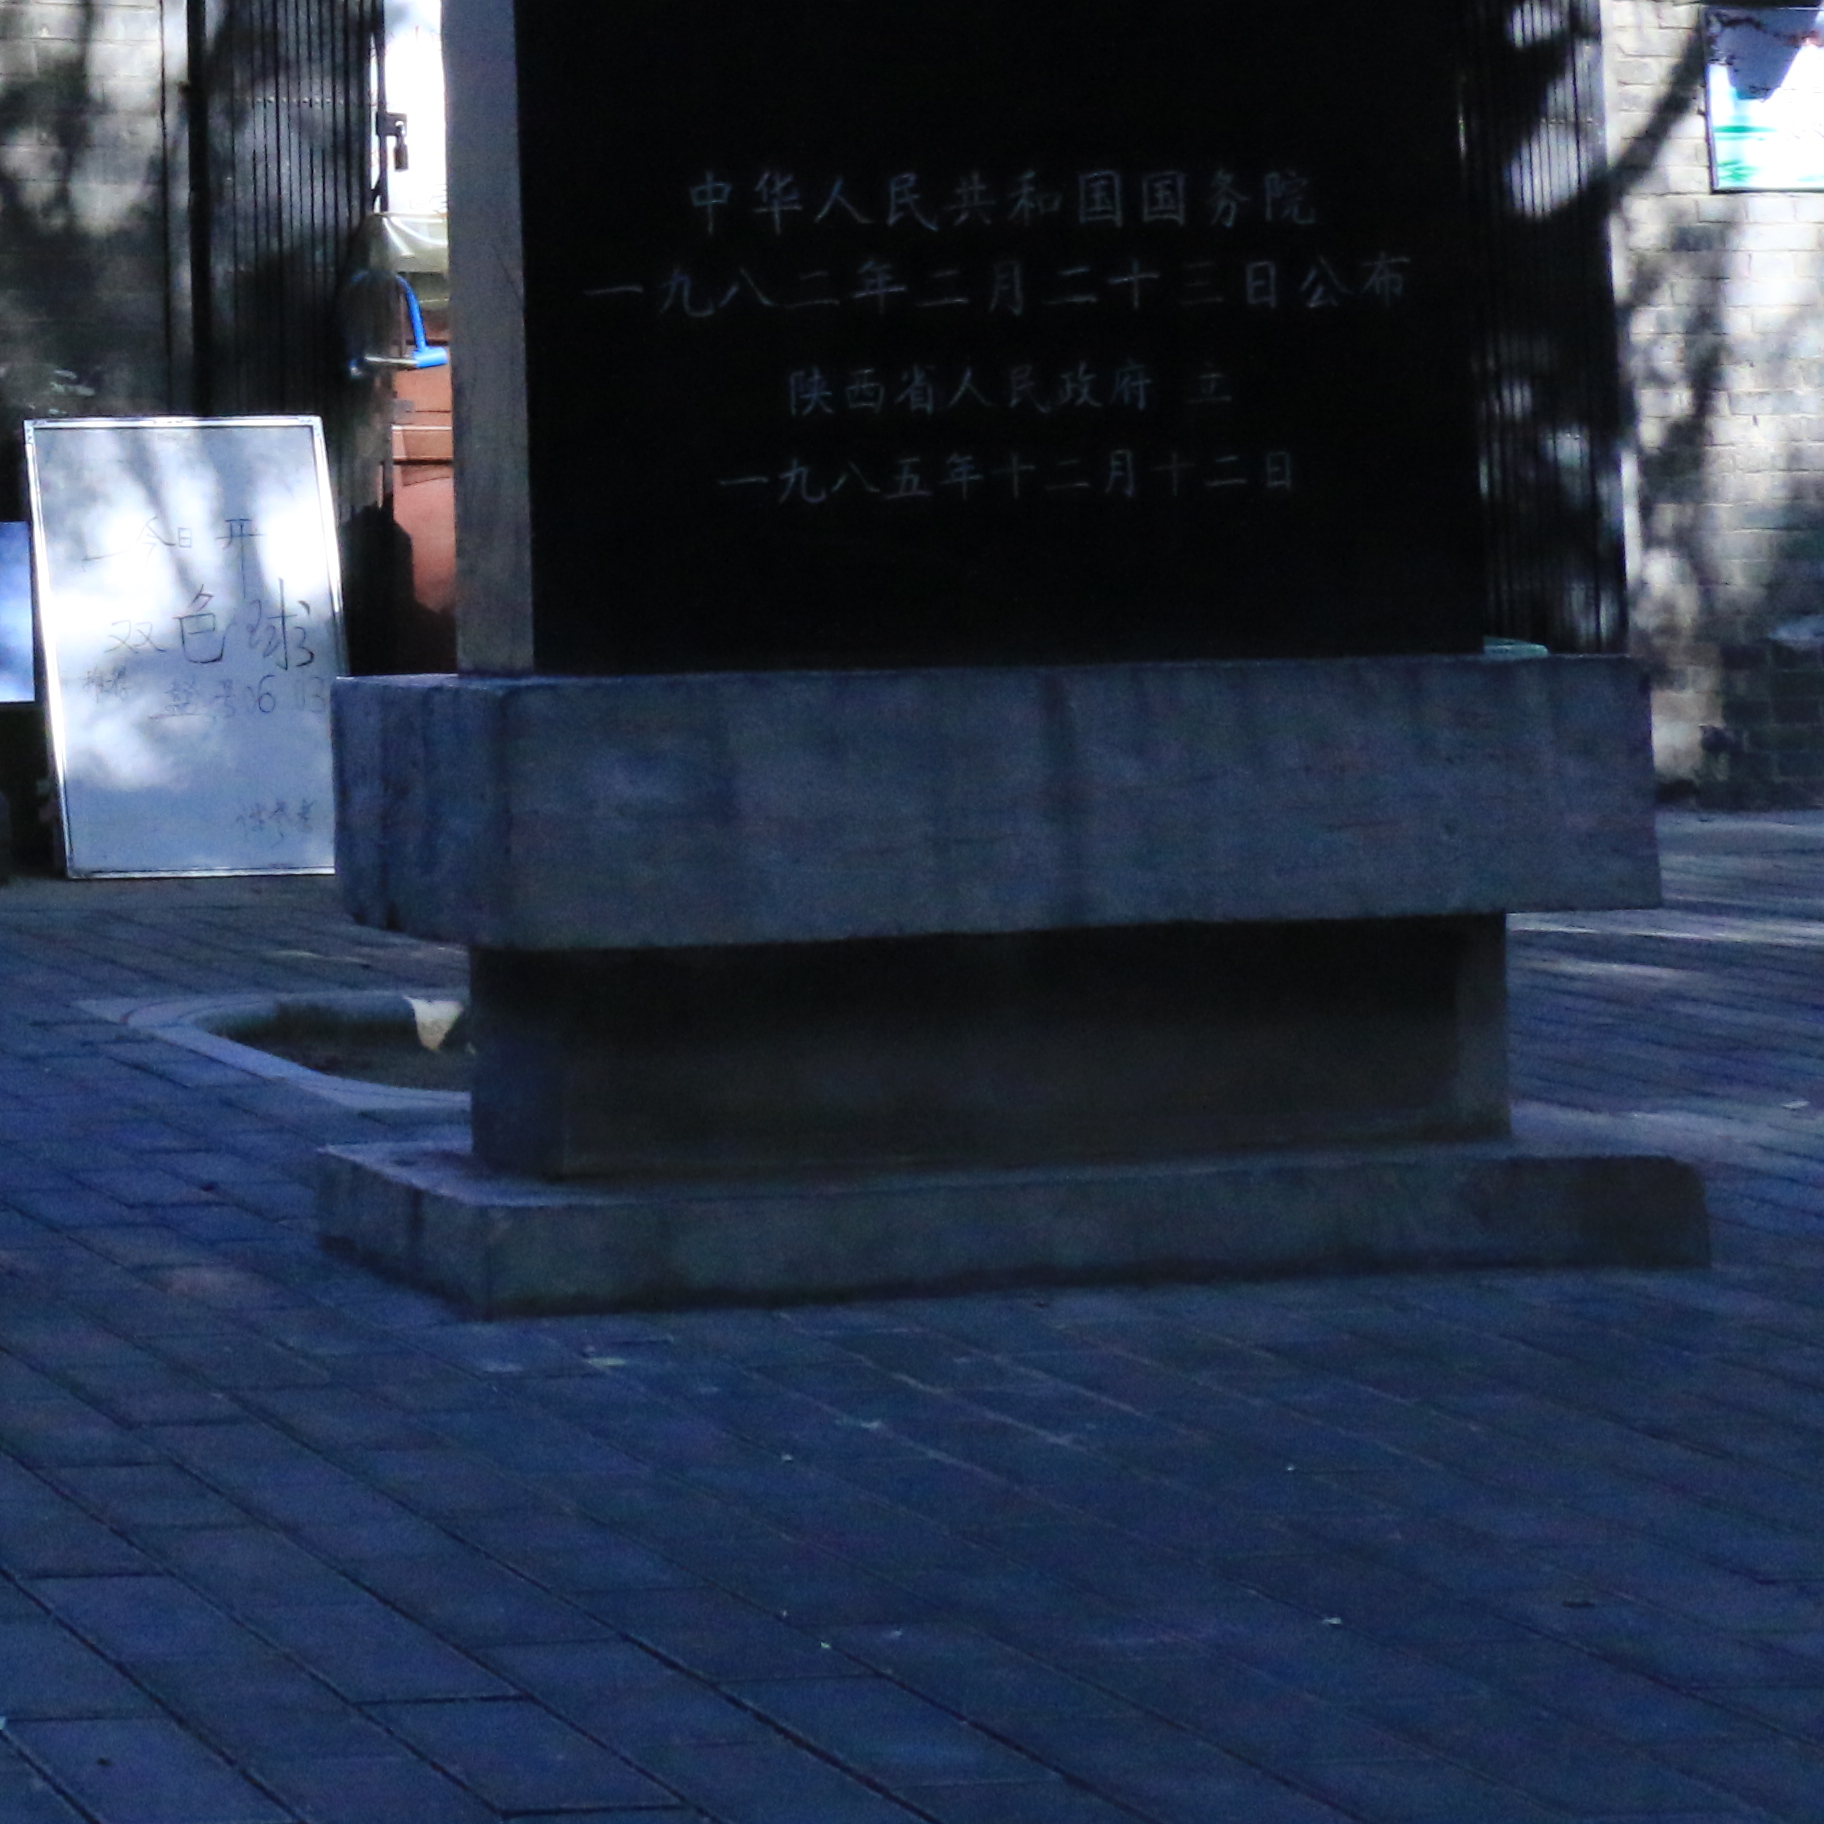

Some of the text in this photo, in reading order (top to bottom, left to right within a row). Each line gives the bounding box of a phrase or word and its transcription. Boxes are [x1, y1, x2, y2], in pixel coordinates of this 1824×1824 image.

[688, 169, 1316, 235] 中华人民共和国国务院
[584, 250, 1411, 319] 一九八二年二月二十三日公布
[788, 364, 1154, 417] 陕西省人民政府
[715, 449, 1294, 504] 一九八五年十二月十二日
[104, 578, 317, 670] 双色球
